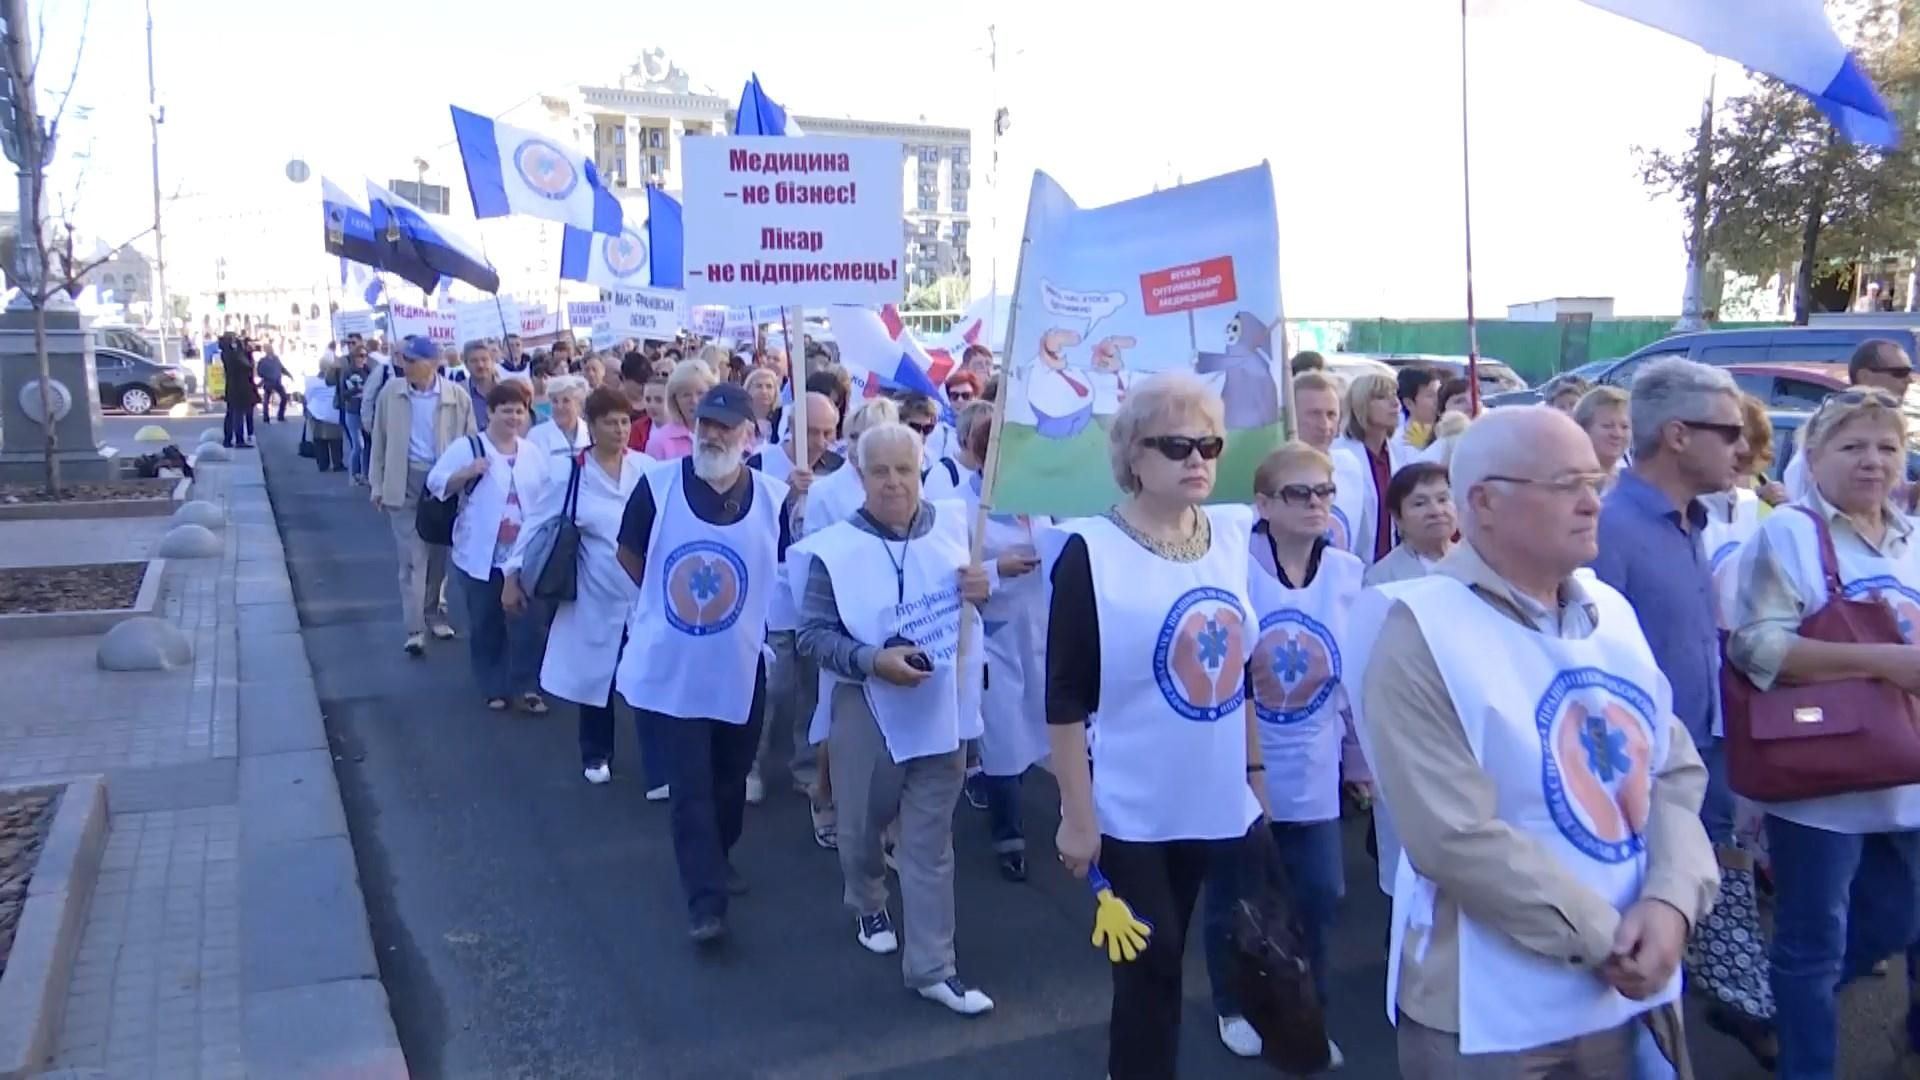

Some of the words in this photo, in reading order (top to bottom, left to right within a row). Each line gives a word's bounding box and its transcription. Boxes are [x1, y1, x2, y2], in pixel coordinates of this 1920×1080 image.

[729, 148, 850, 174] Медицина
[742, 184, 770, 204] не
[775, 181, 856, 204] бізнес!
[761, 227, 823, 252] Лікар
[708, 262, 735, 282] не
[740, 259, 898, 284] підприємець!
